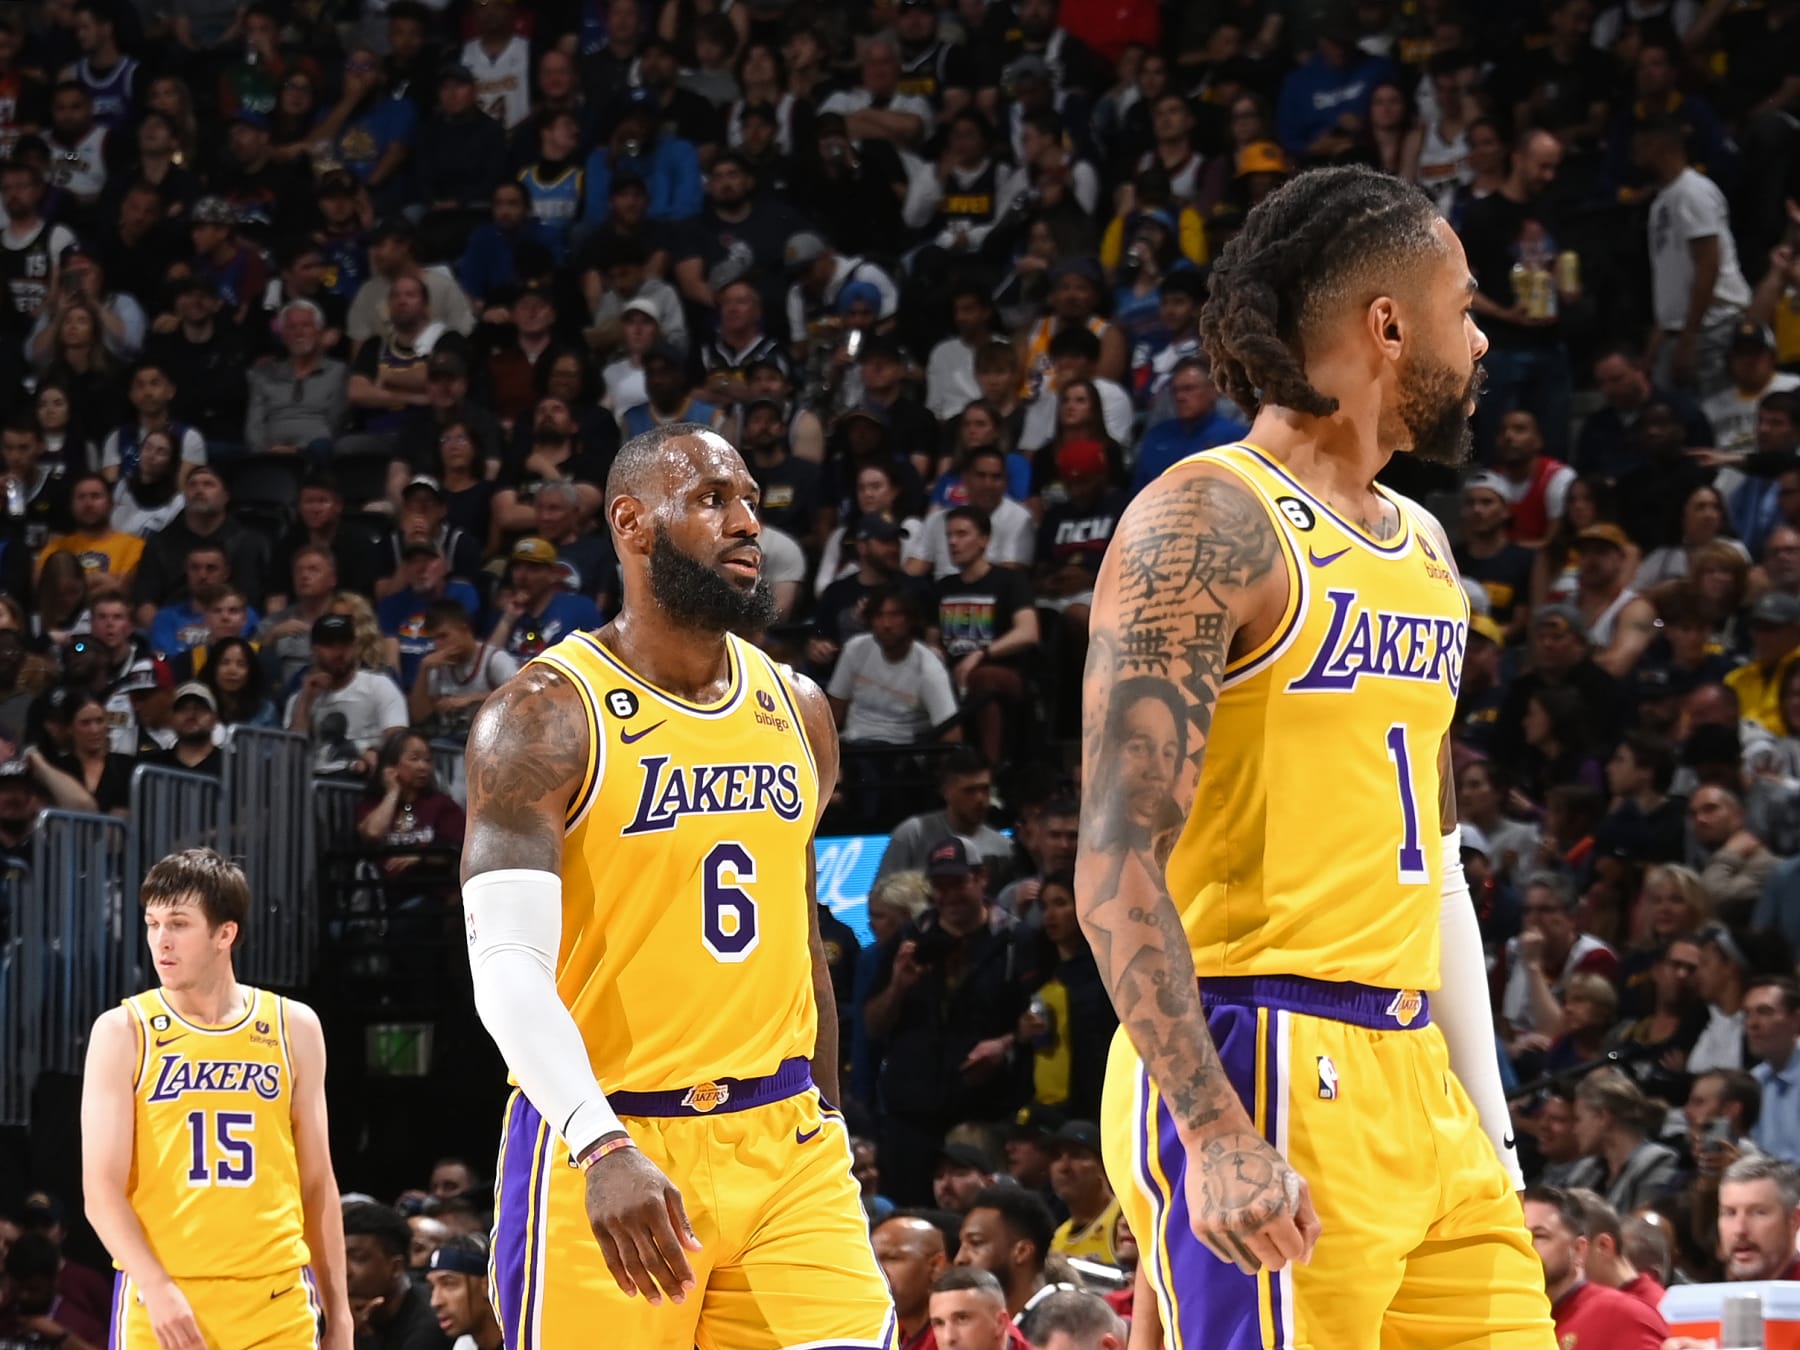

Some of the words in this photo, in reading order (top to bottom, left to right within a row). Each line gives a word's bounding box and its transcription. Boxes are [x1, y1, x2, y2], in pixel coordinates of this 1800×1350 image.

[1283, 590, 1468, 699] LAKERS
[610, 691, 632, 717] 6
[755, 711, 790, 732] bibigo
[620, 753, 803, 837] LAKERS
[1385, 722, 1431, 885] 1
[701, 839, 760, 964] 6
[146, 1053, 281, 1104] LAKERS
[681, 1084, 729, 1106] LAKERS
[186, 1110, 256, 1187] 15
